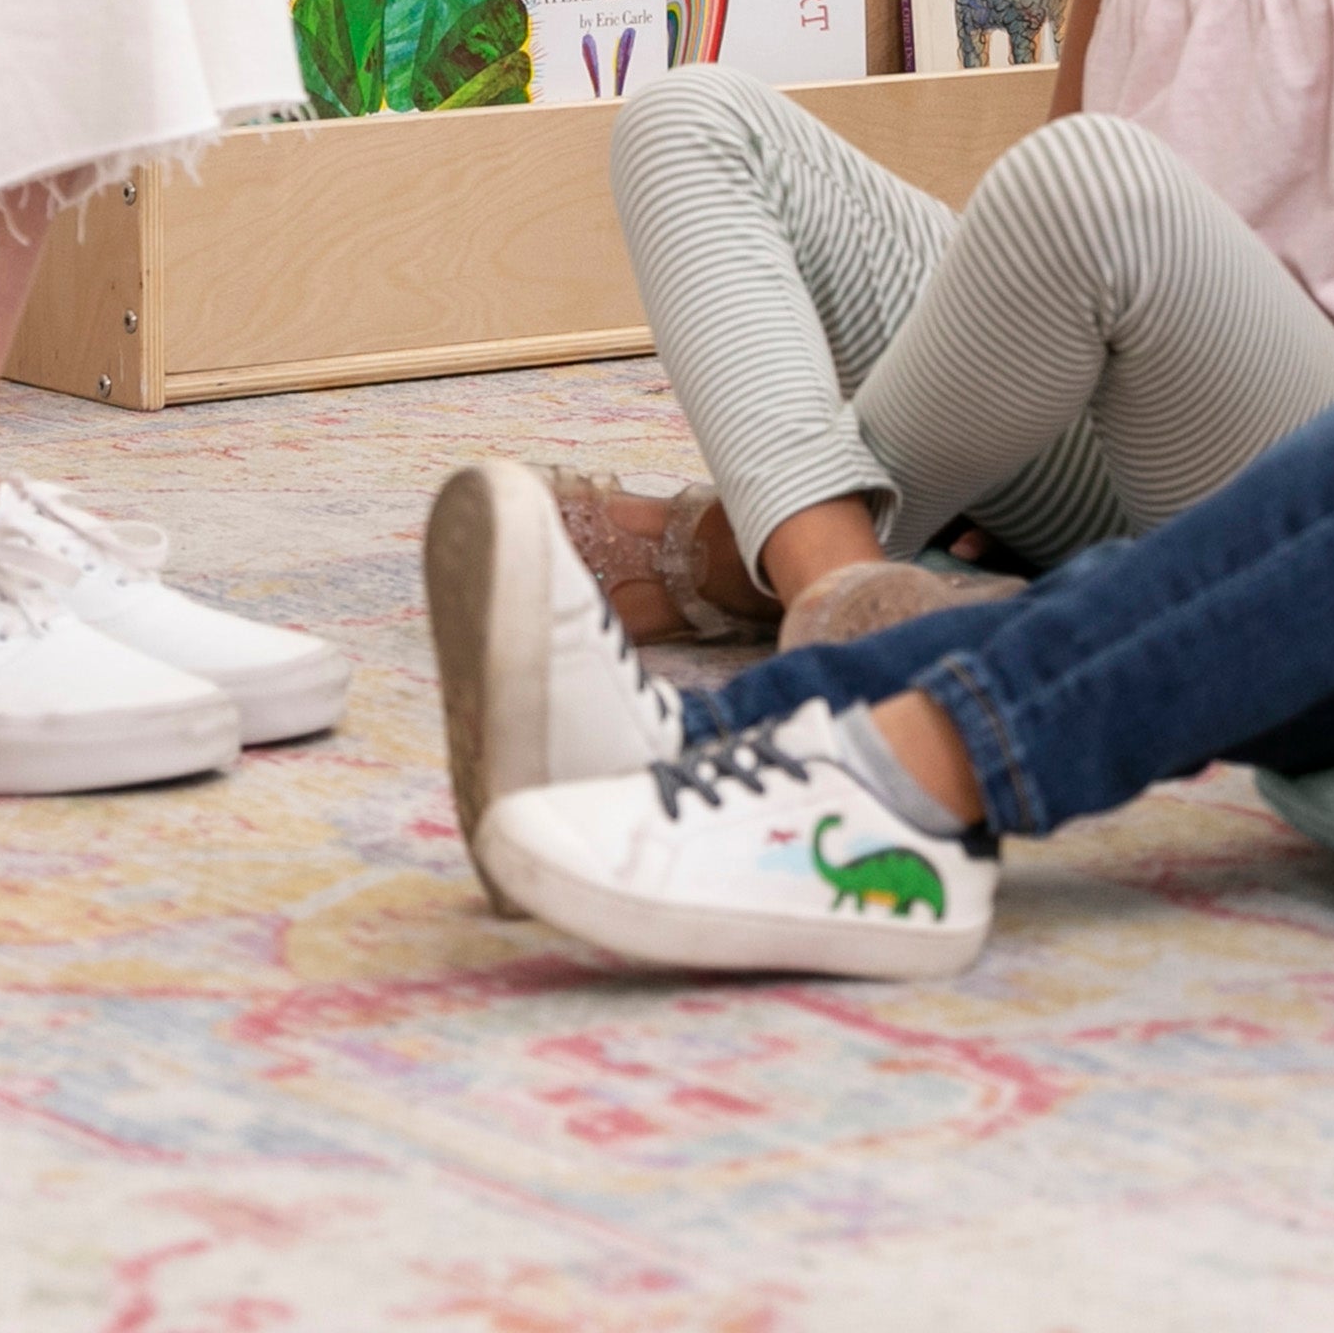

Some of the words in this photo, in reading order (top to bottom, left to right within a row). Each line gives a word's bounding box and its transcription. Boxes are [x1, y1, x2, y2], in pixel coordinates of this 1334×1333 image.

[579, 14, 594, 30] by
[596, 12, 621, 27] Eric
[624, 10, 653, 25] Carle
